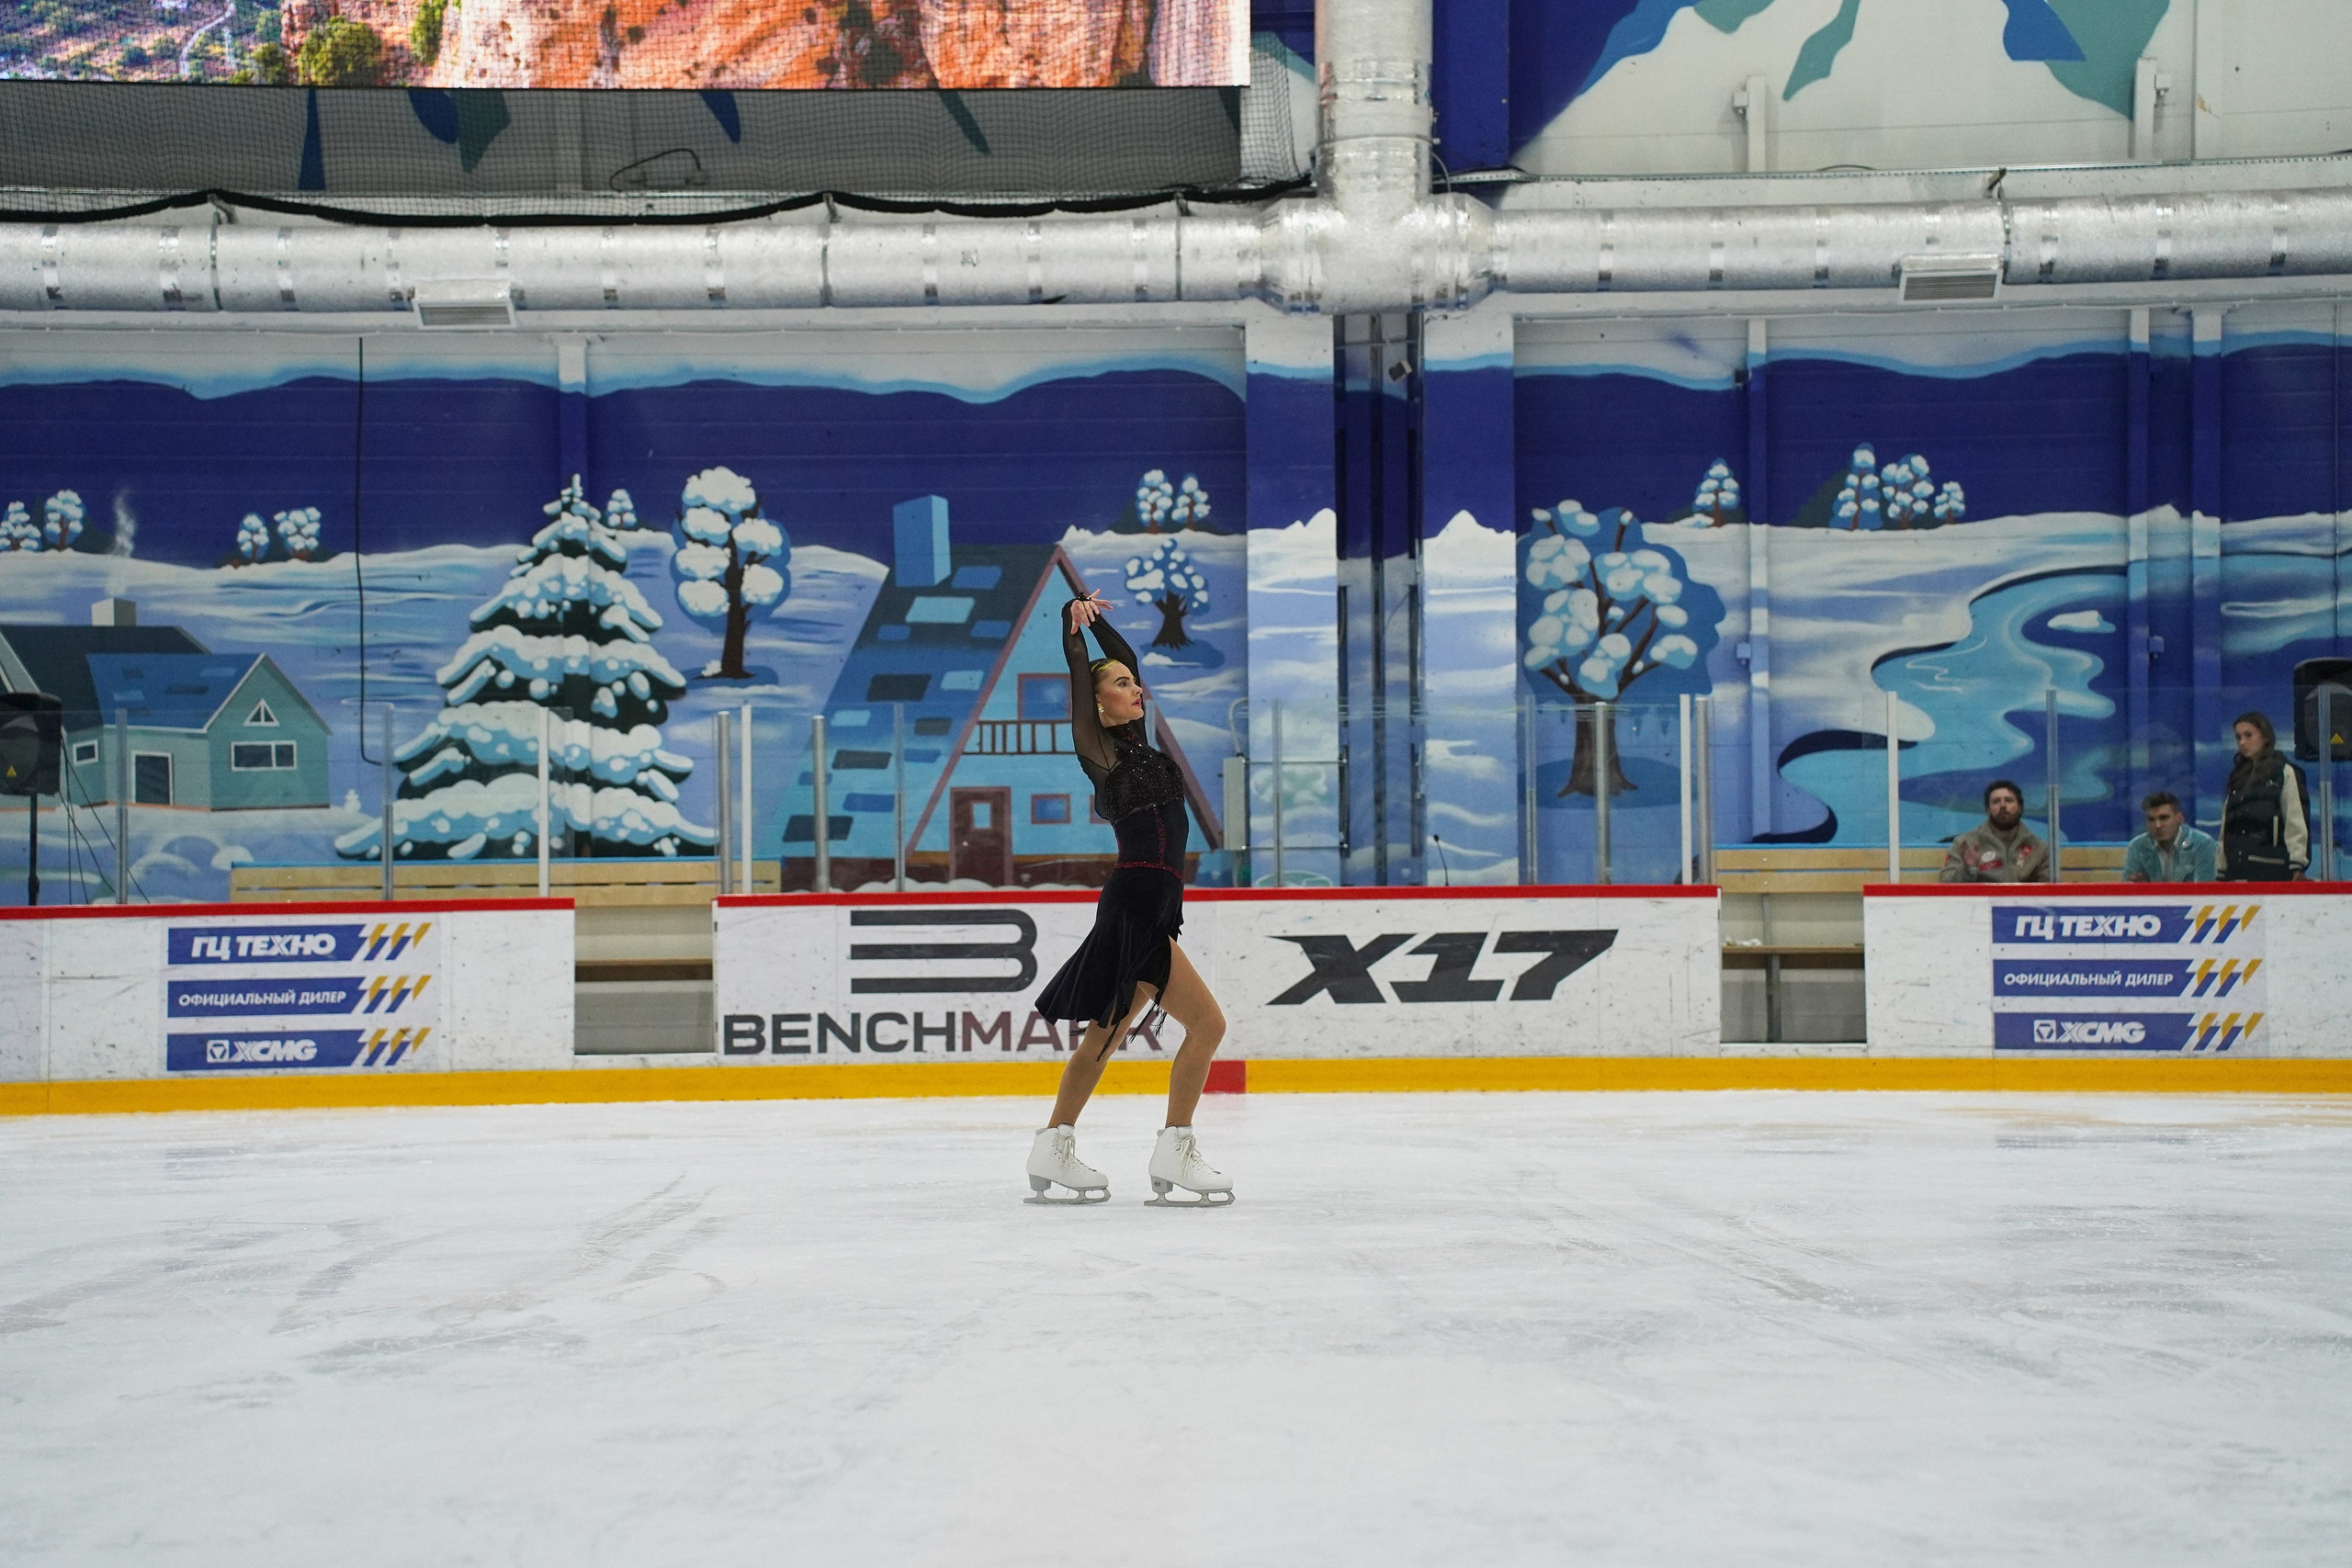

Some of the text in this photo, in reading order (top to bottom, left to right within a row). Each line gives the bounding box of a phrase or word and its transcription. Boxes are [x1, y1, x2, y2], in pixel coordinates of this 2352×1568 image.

[2015, 915, 2161, 940] ГЦ ТЕХНО
[191, 933, 336, 960] ГЦ ТЕХНО
[1267, 930, 1619, 1006] X17
[2004, 970, 2174, 987] ОФИЦИАЛЬНЫЙ ДИЛЕР
[178, 988, 346, 1008] ОФИЦИАЛЬНЫЙ ДИЛЕР
[2060, 1021, 2146, 1043] XCMG
[232, 1040, 318, 1063] XCMG
